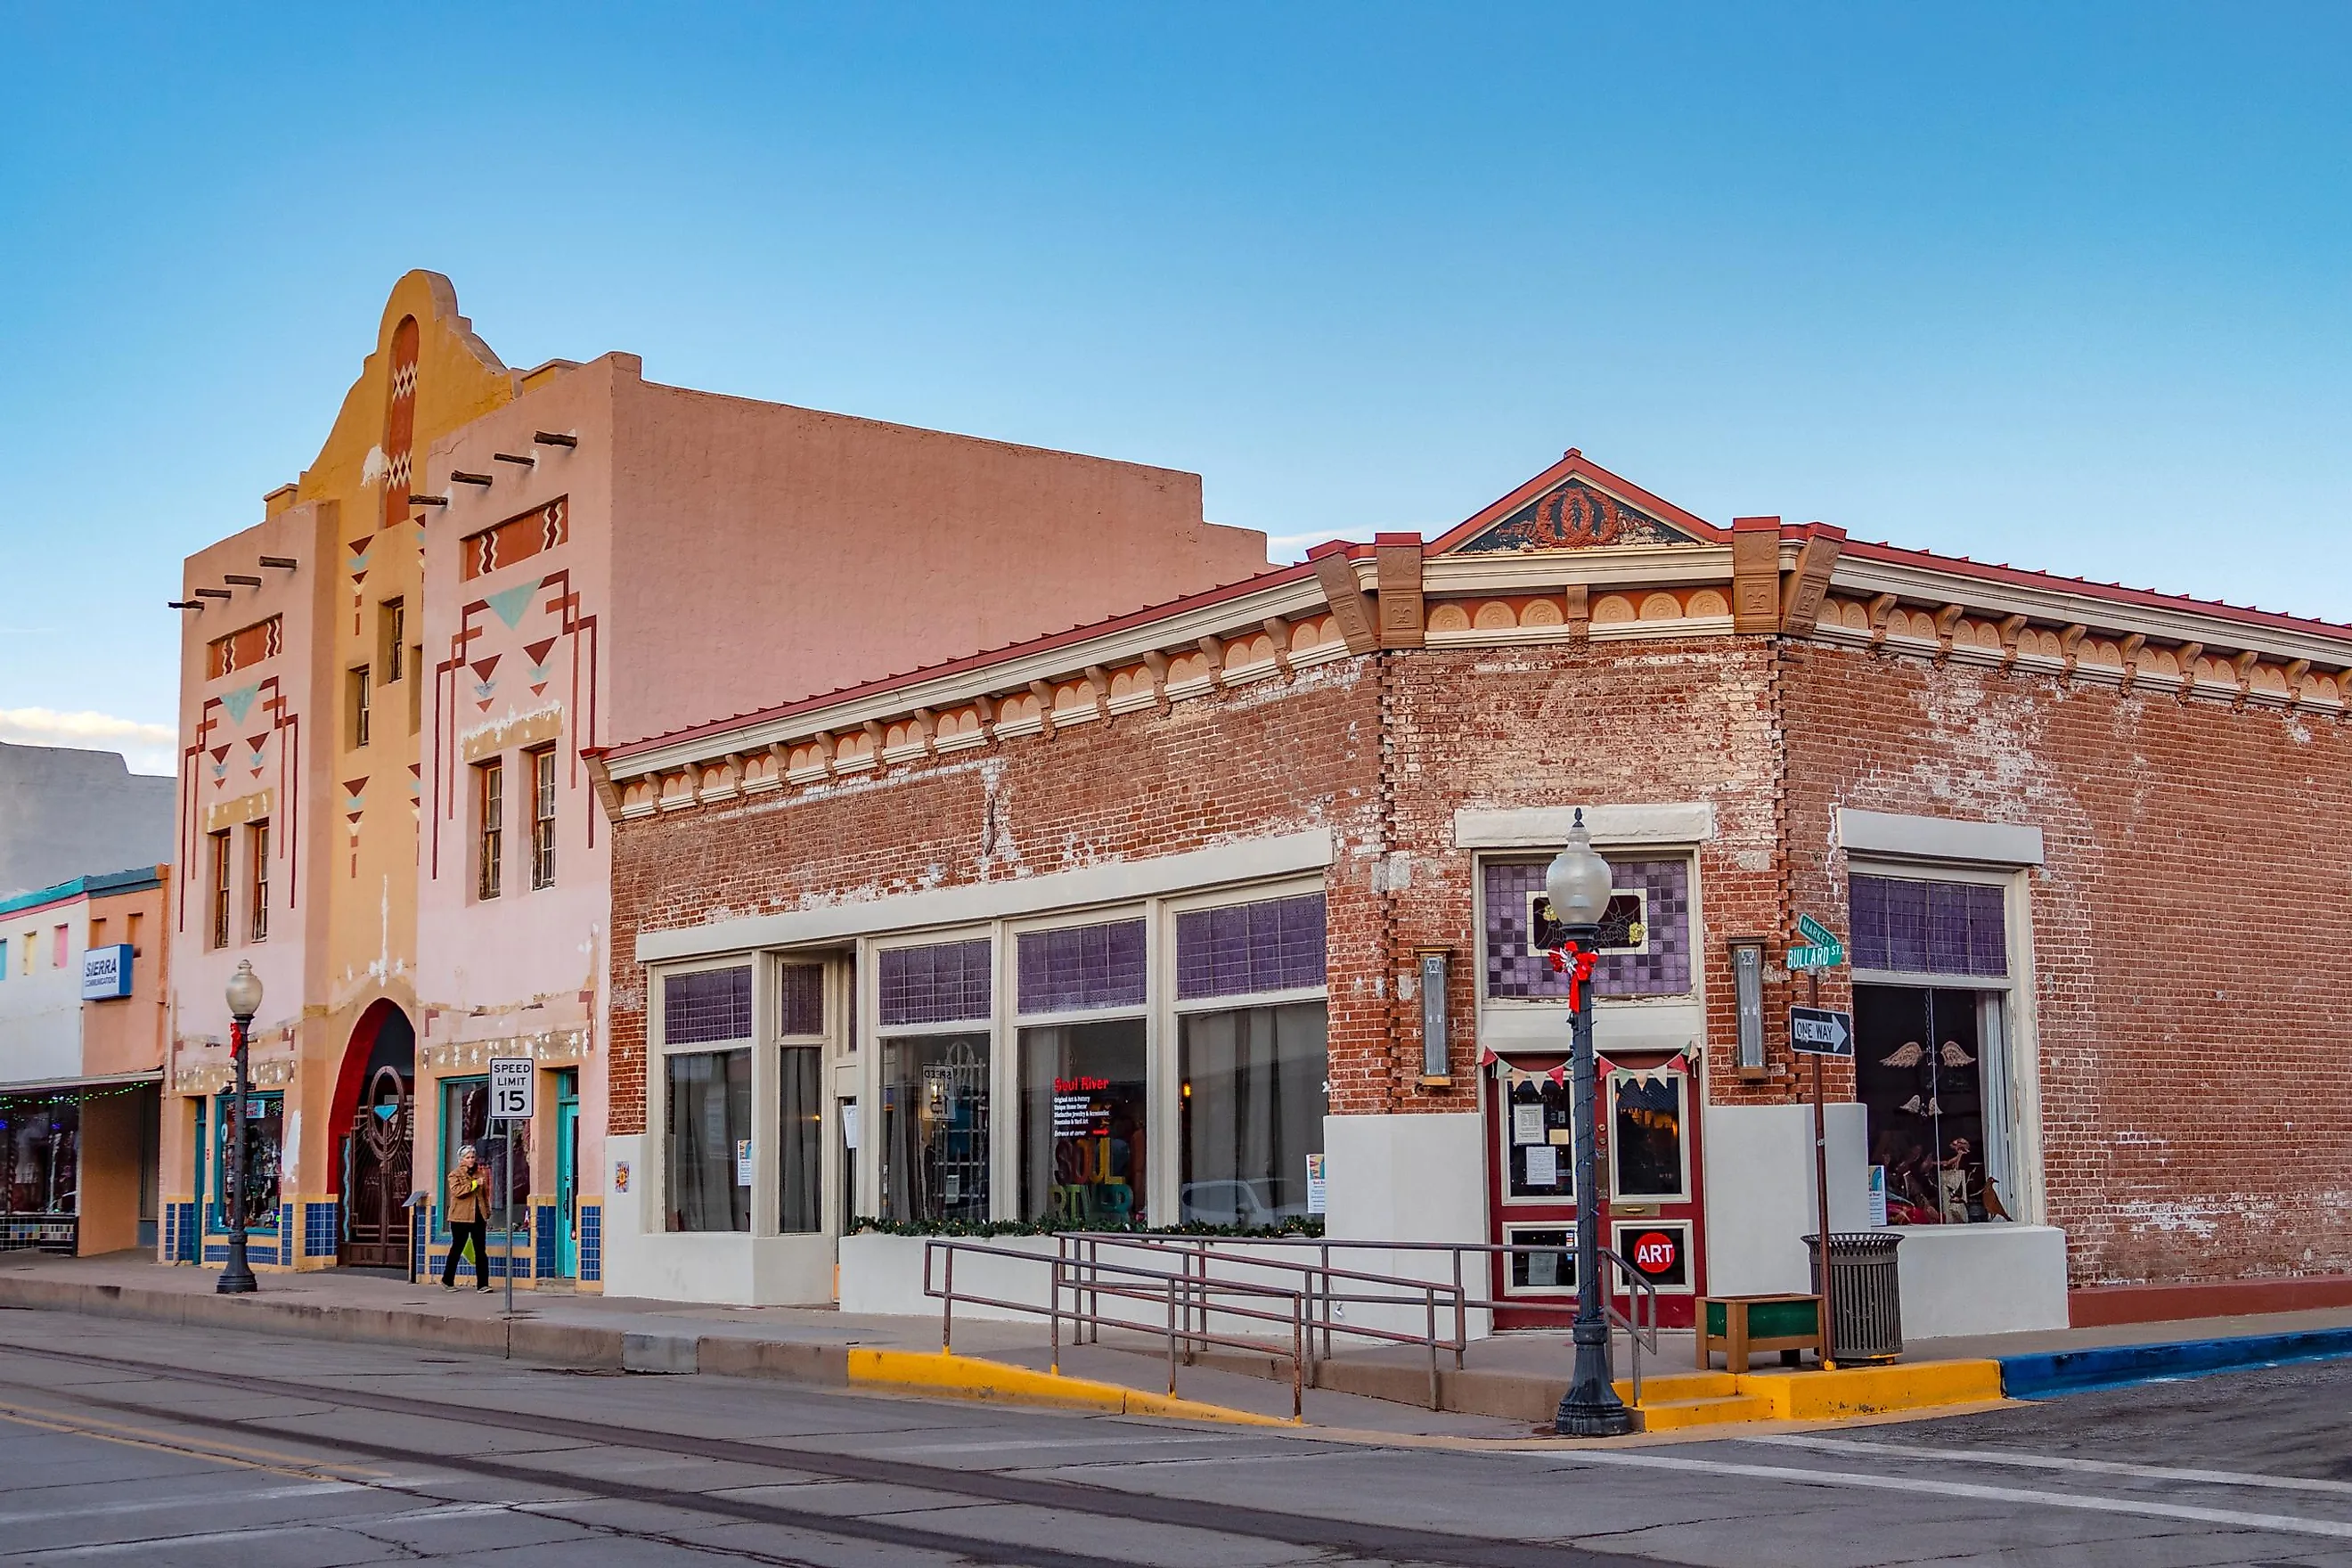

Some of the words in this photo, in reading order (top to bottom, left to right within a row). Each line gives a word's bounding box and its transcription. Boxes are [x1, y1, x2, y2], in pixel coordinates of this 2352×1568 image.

[1801, 919, 1831, 945] MARKET
[1787, 947, 1829, 968] BULLARD
[86, 958, 117, 977] SIERRA
[1797, 1022, 1813, 1039] ONE
[1816, 1024, 1833, 1041] WAY
[494, 1064, 531, 1074] SPEED
[497, 1077, 527, 1086] LIMIT
[1054, 1076, 1079, 1092] Soul
[1081, 1076, 1110, 1090] River
[498, 1090, 526, 1112] 15
[1054, 1137, 1126, 1186] SOUL
[1637, 1244, 1673, 1264] ART
